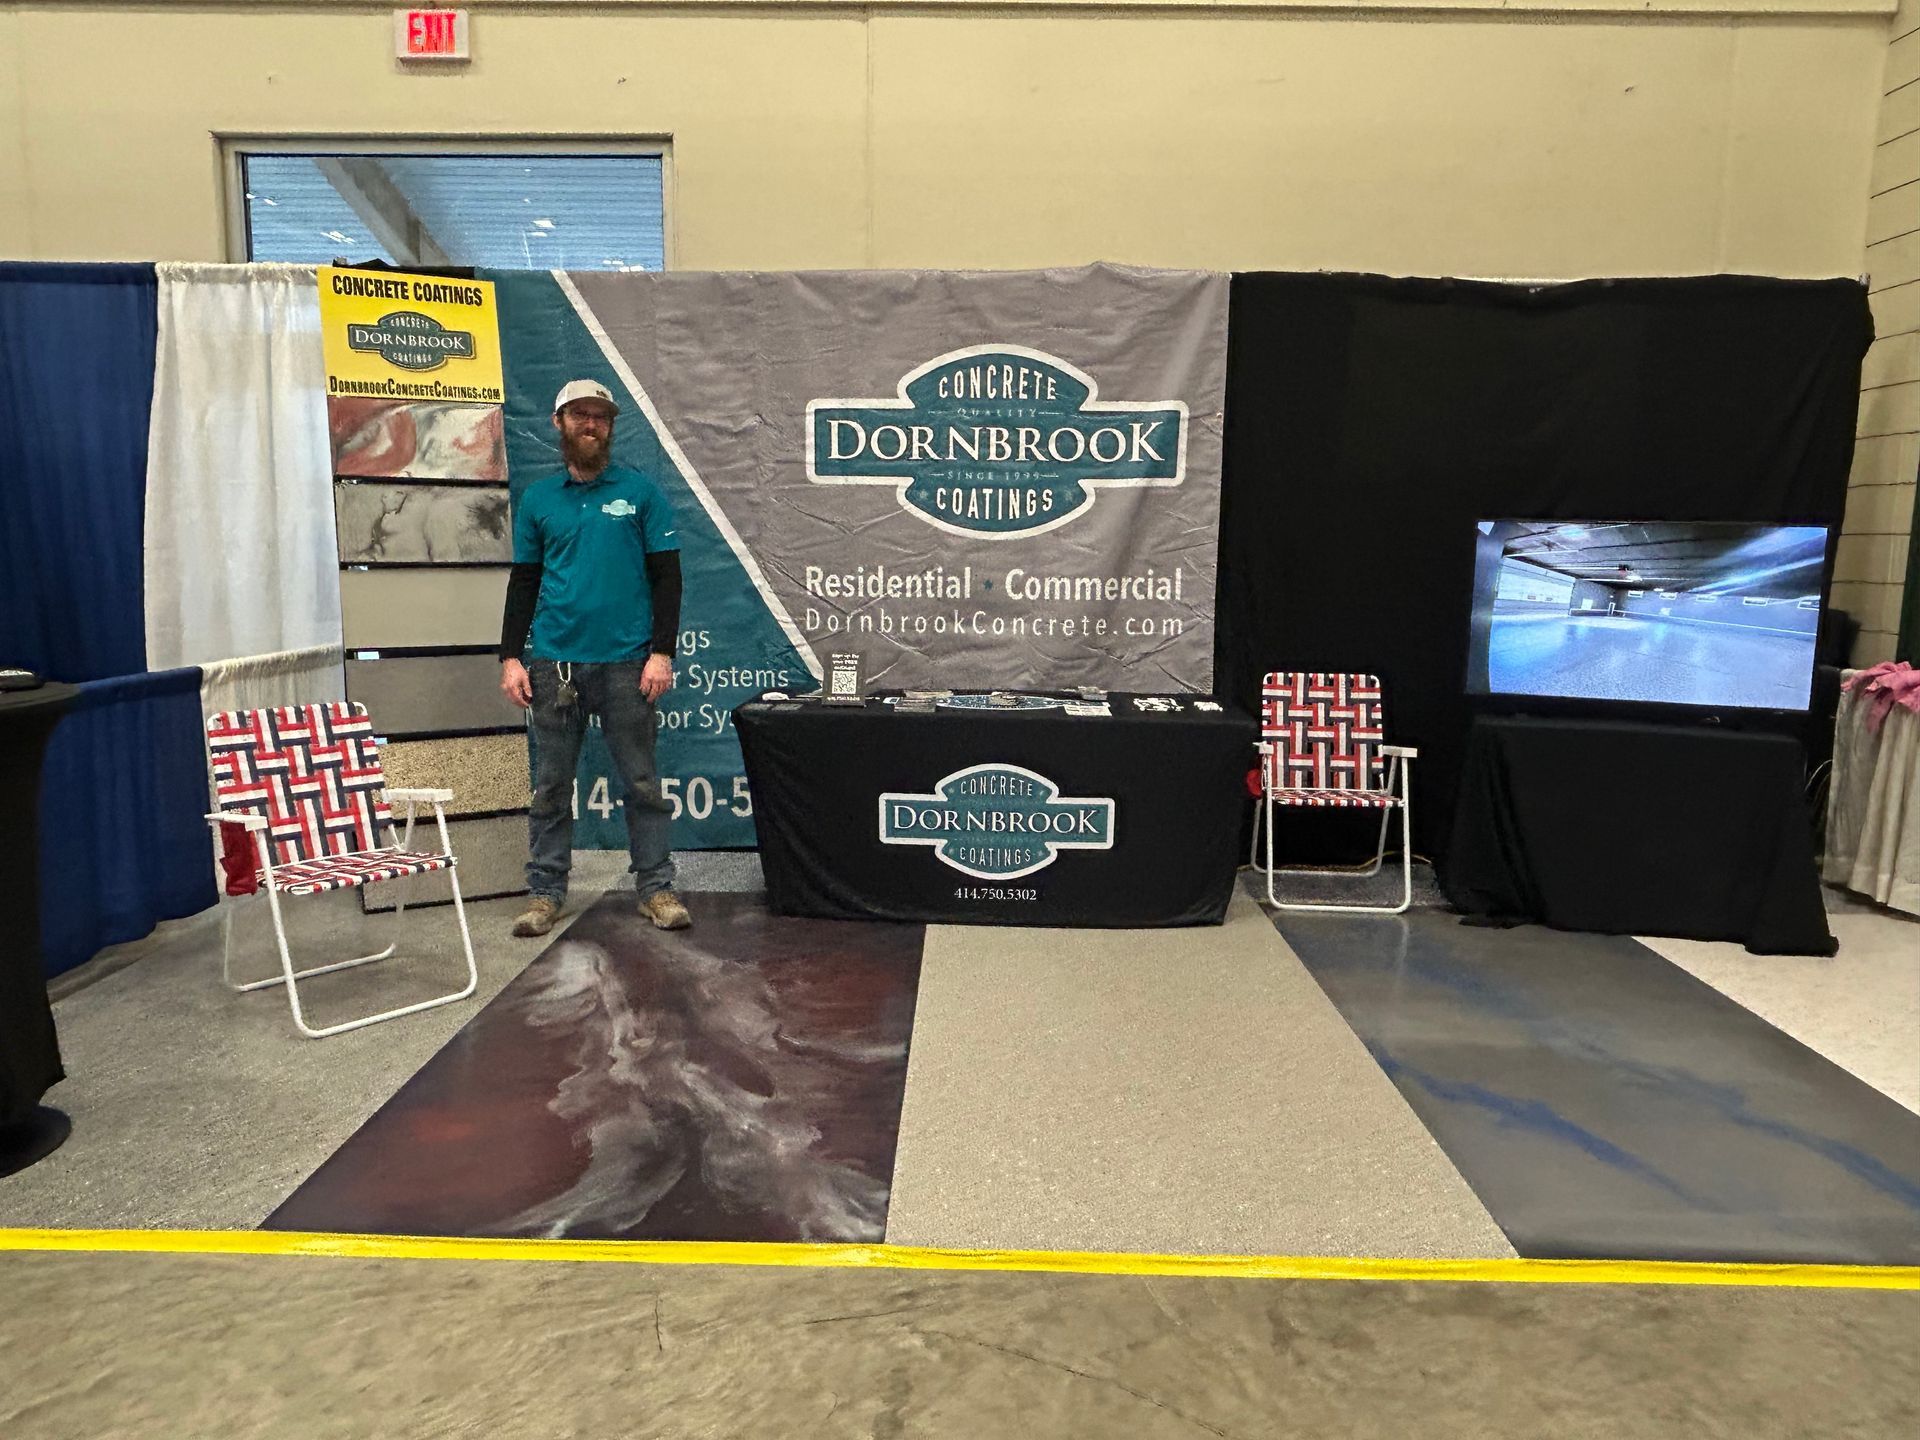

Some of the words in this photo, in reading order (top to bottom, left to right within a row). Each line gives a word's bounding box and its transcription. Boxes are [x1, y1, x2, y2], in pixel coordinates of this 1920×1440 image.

[408, 12, 456, 54] EXIT
[332, 275, 410, 300] CONCRETE
[413, 282, 483, 307] COATINGS
[355, 329, 466, 350] DORNBROOK
[392, 352, 432, 363] COATINGS
[938, 365, 1058, 401] CONCRETE
[826, 419, 1165, 463] DORNBROOK
[947, 470, 994, 480] SINCE
[936, 487, 1054, 521] COATINGS
[805, 566, 972, 600] Residential
[1005, 569, 1183, 601] Commercial
[805, 608, 1184, 637] DornbrookConcrete.com
[688, 664, 789, 695] Systems
[960, 775, 1034, 797] CONCRETE
[893, 805, 1100, 835] DORNBROOK
[959, 847, 1032, 867] COATINGS
[953, 887, 1038, 901] 414.750.5302
